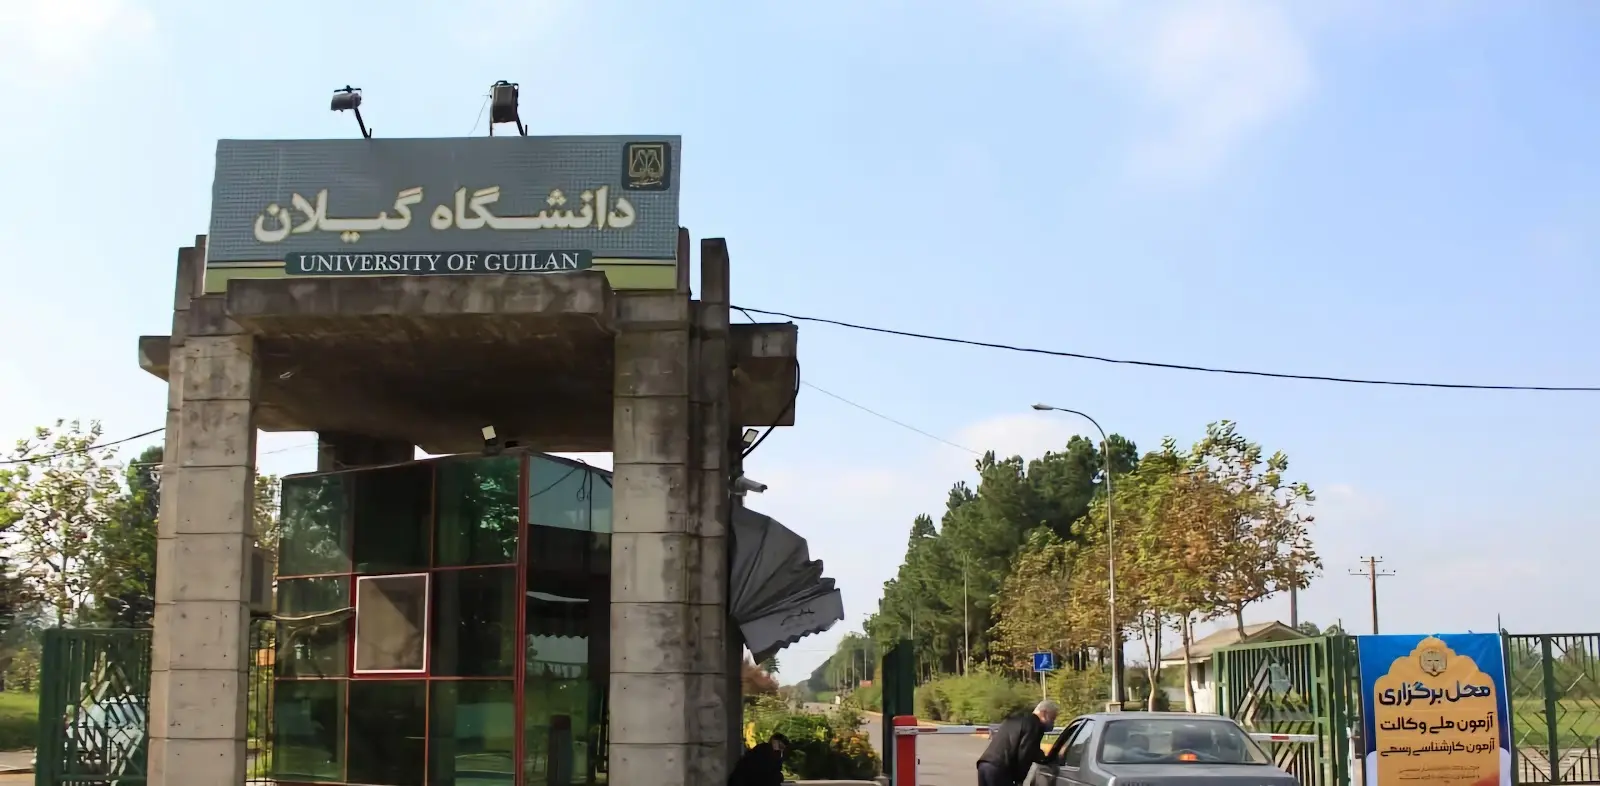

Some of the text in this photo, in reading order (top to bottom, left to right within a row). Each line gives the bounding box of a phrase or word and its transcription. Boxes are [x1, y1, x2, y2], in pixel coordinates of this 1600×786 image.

[254, 185, 636, 243] دانشگاه گیلان
[300, 252, 579, 272] UNIVERSITY OF GUILAN
[1378, 680, 1491, 706] محل برگزاری
[1380, 711, 1494, 734] آزمون ملی وکالت
[1380, 737, 1495, 757] آزمون کارشناسی رسمی
